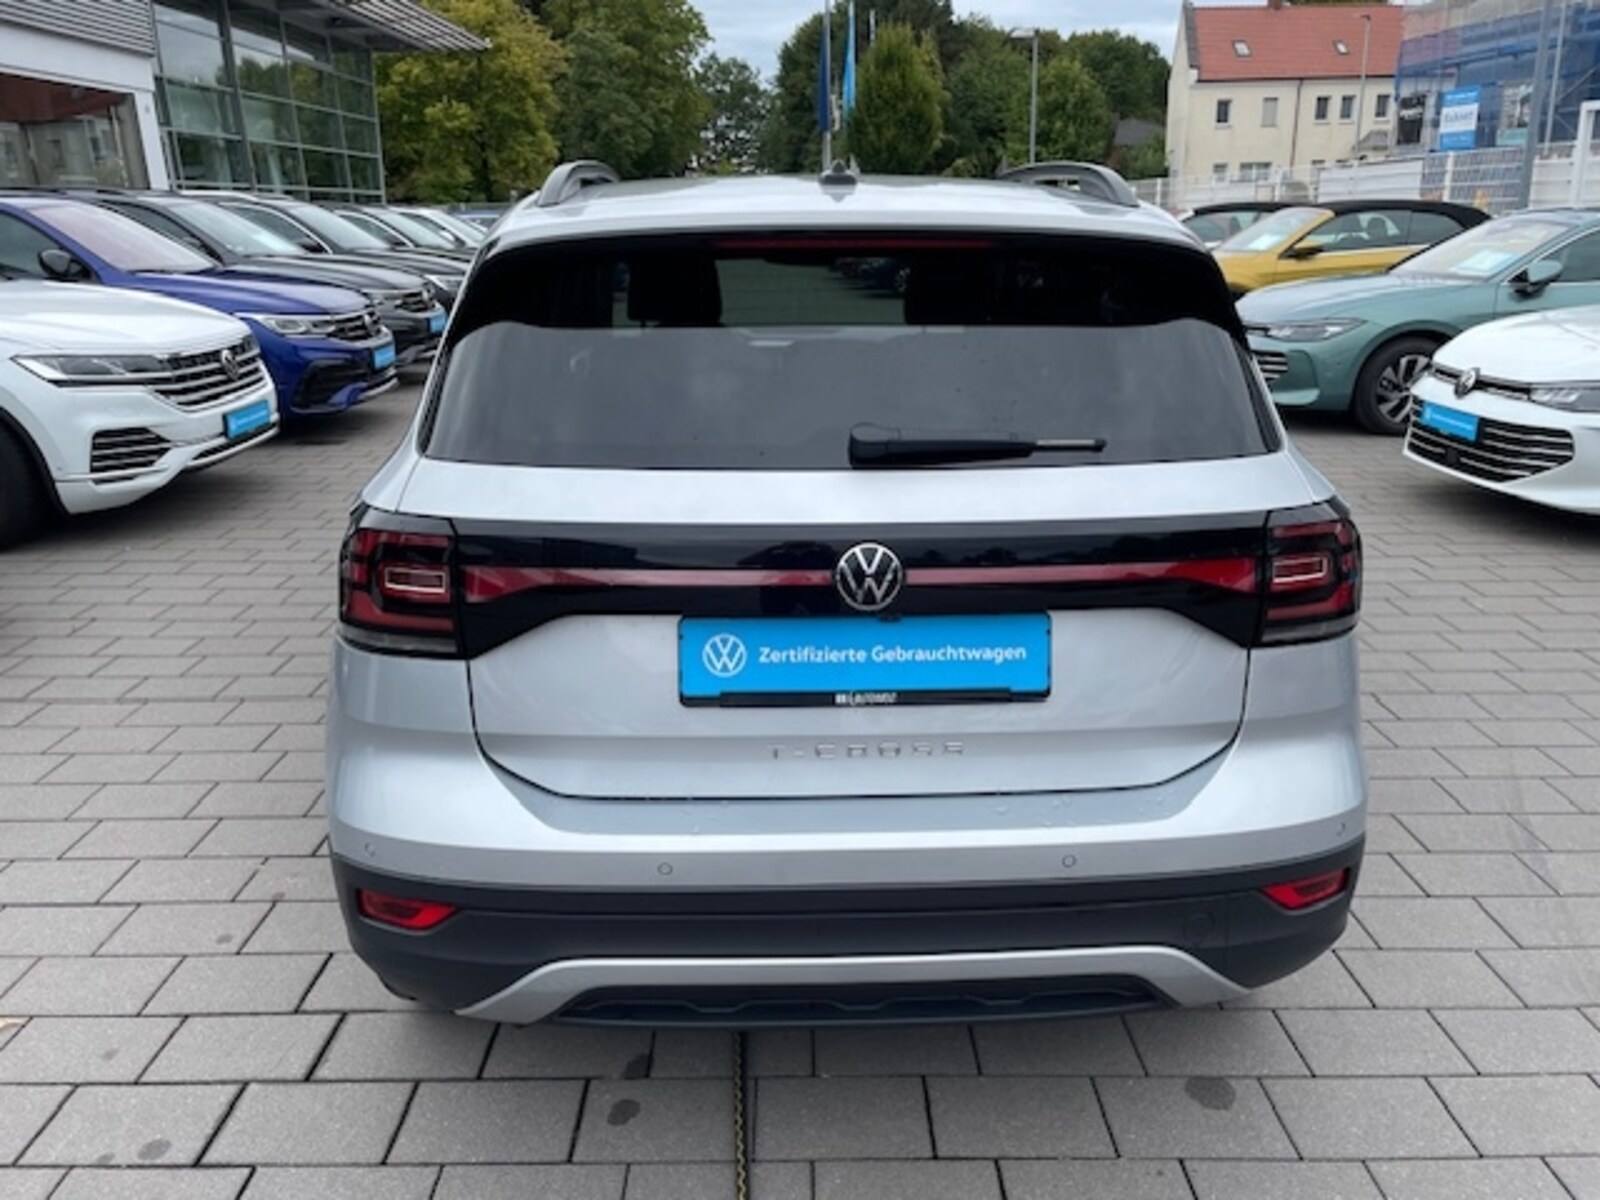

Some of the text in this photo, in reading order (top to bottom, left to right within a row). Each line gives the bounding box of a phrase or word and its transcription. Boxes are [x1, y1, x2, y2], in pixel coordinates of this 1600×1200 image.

[758, 646, 867, 664] Zertifizierte
[871, 644, 1027, 664] Gebrauchtwagen
[767, 741, 964, 760] T-CROSS
